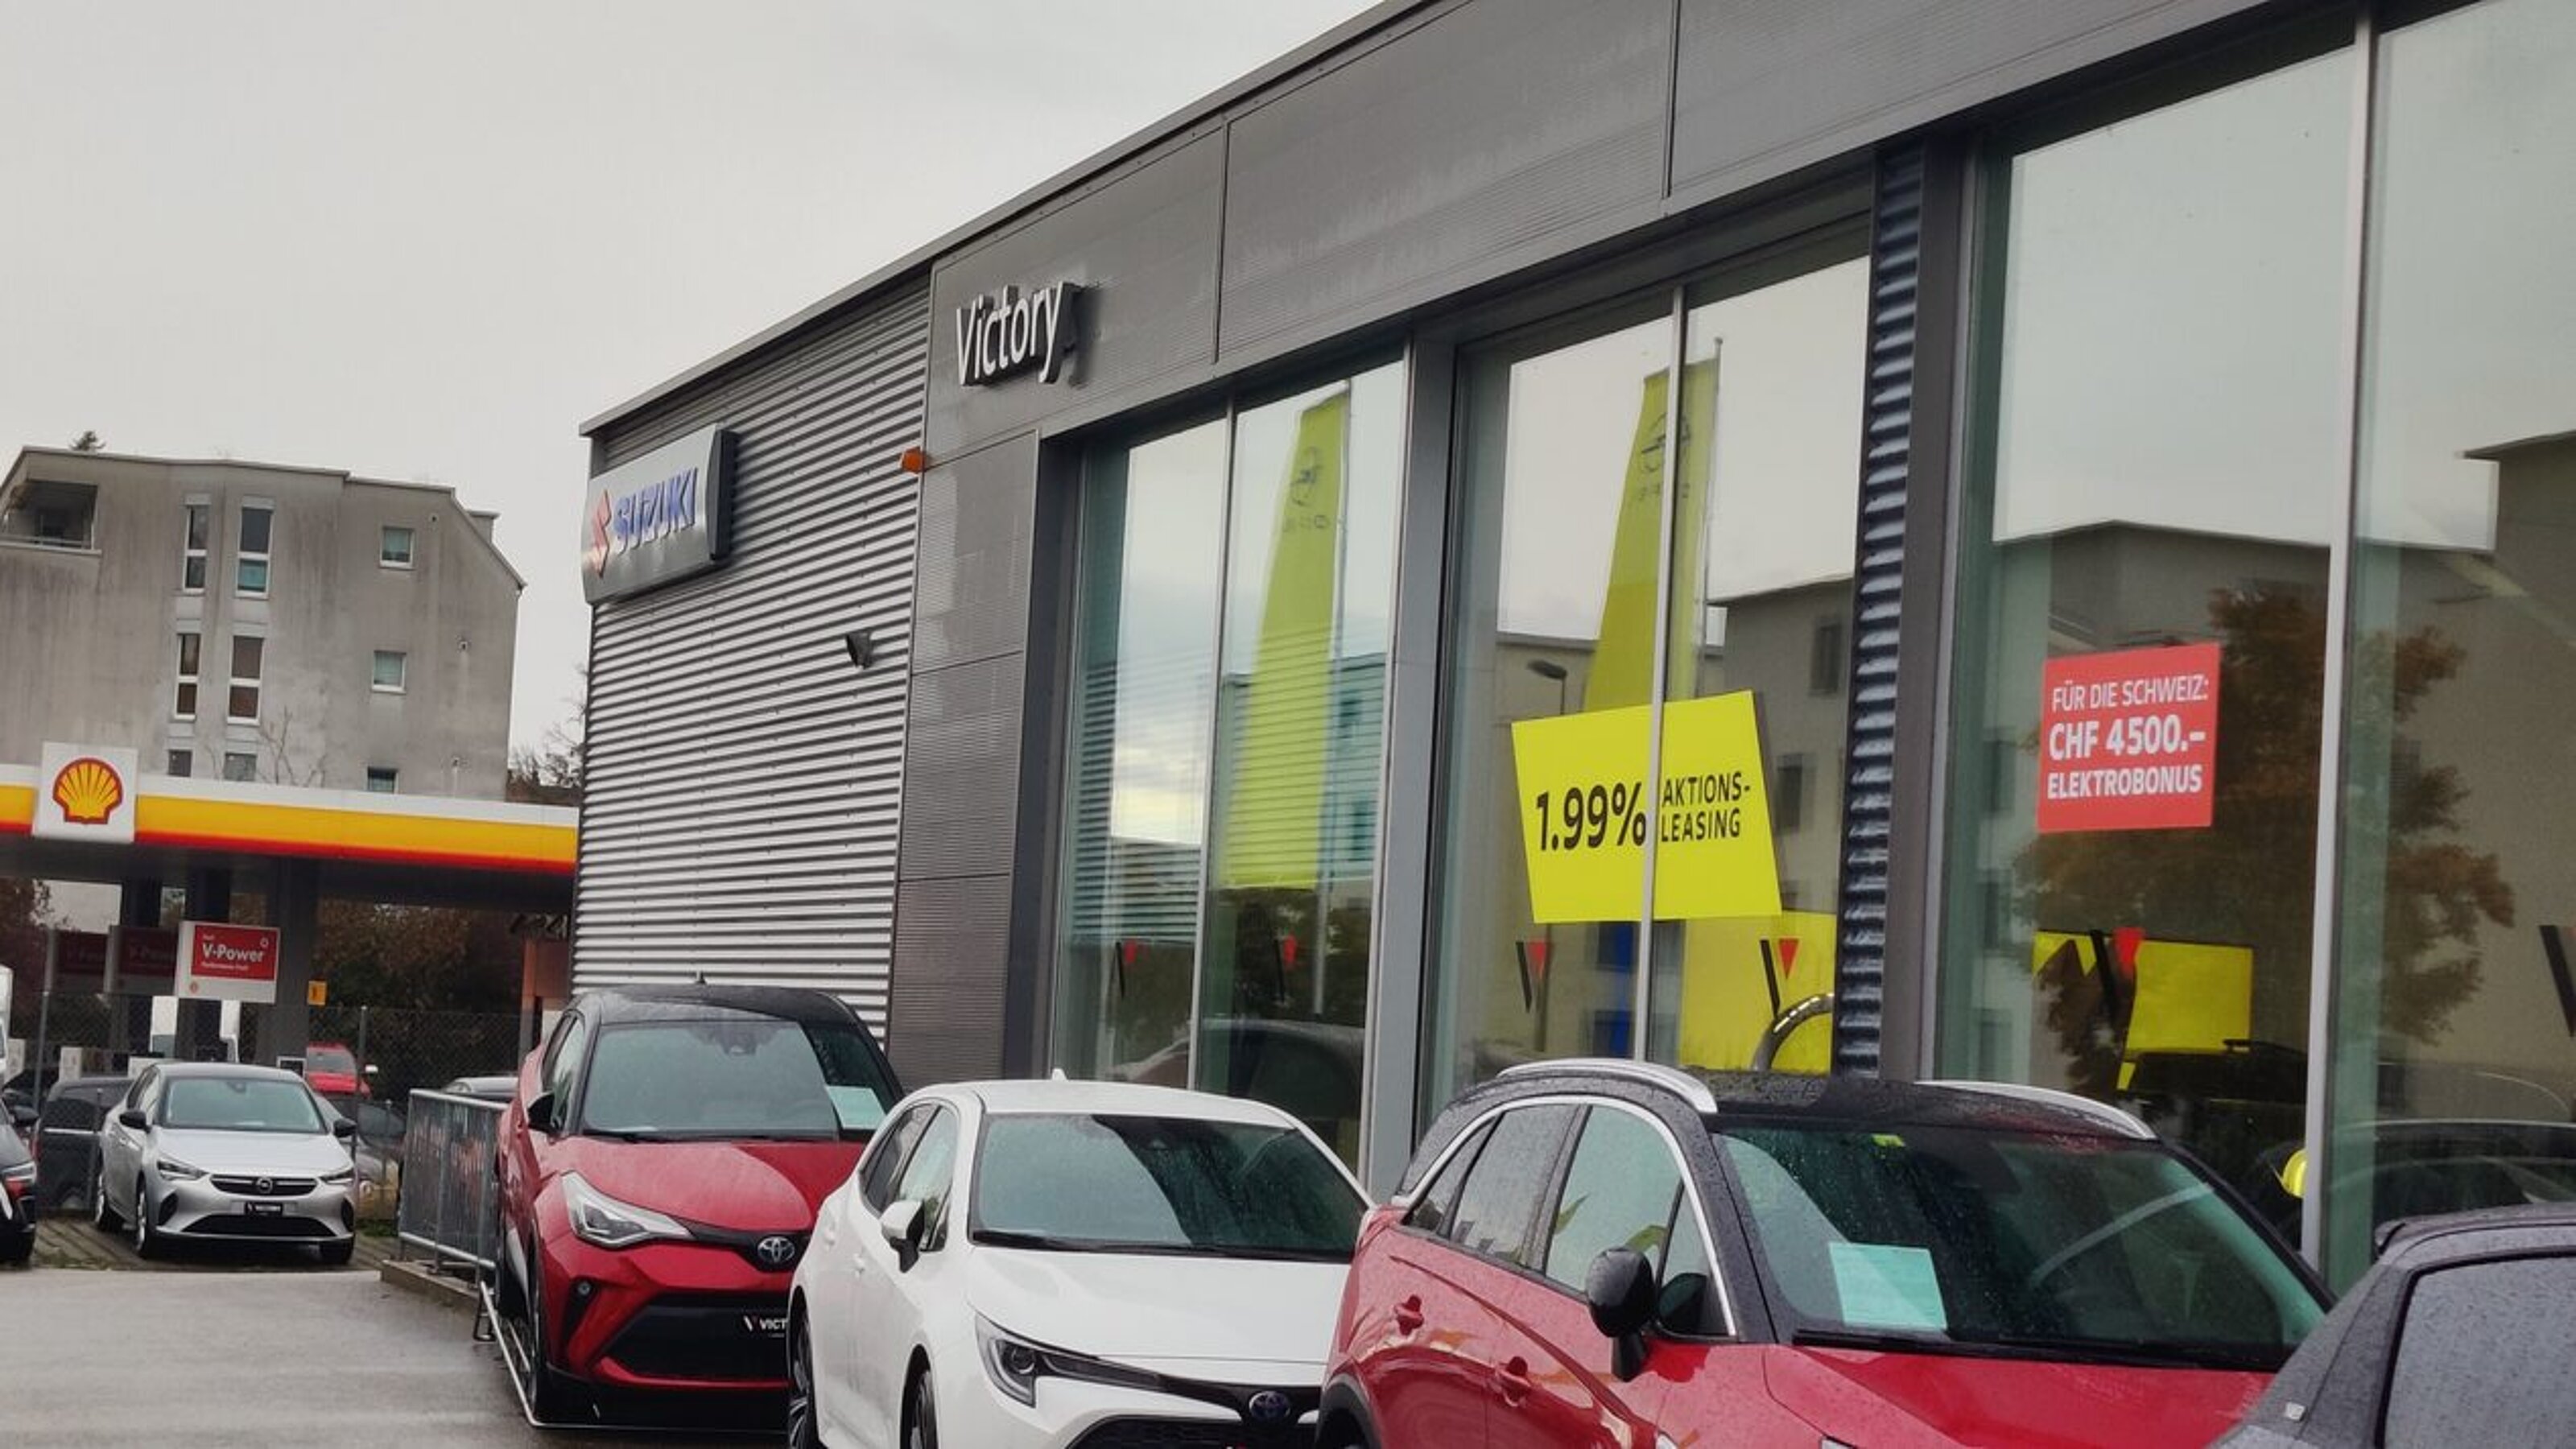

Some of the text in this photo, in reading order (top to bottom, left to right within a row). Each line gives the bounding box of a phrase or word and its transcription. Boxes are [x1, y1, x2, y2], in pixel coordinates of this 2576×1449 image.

[956, 281, 1063, 386] Victory
[613, 467, 698, 557] SUZUKI
[2053, 674, 2209, 712] FÜR DIE SCHWEIZ:
[2049, 721, 2099, 761] CHF
[1662, 771, 1750, 807] AKTIONS-
[2047, 764, 2203, 799] ELEKTROBONUS
[1537, 782, 1647, 851] 1.99%
[1661, 807, 1740, 842] LEASING
[202, 942, 265, 962] V-Power
[759, 1318, 789, 1330] VICT
